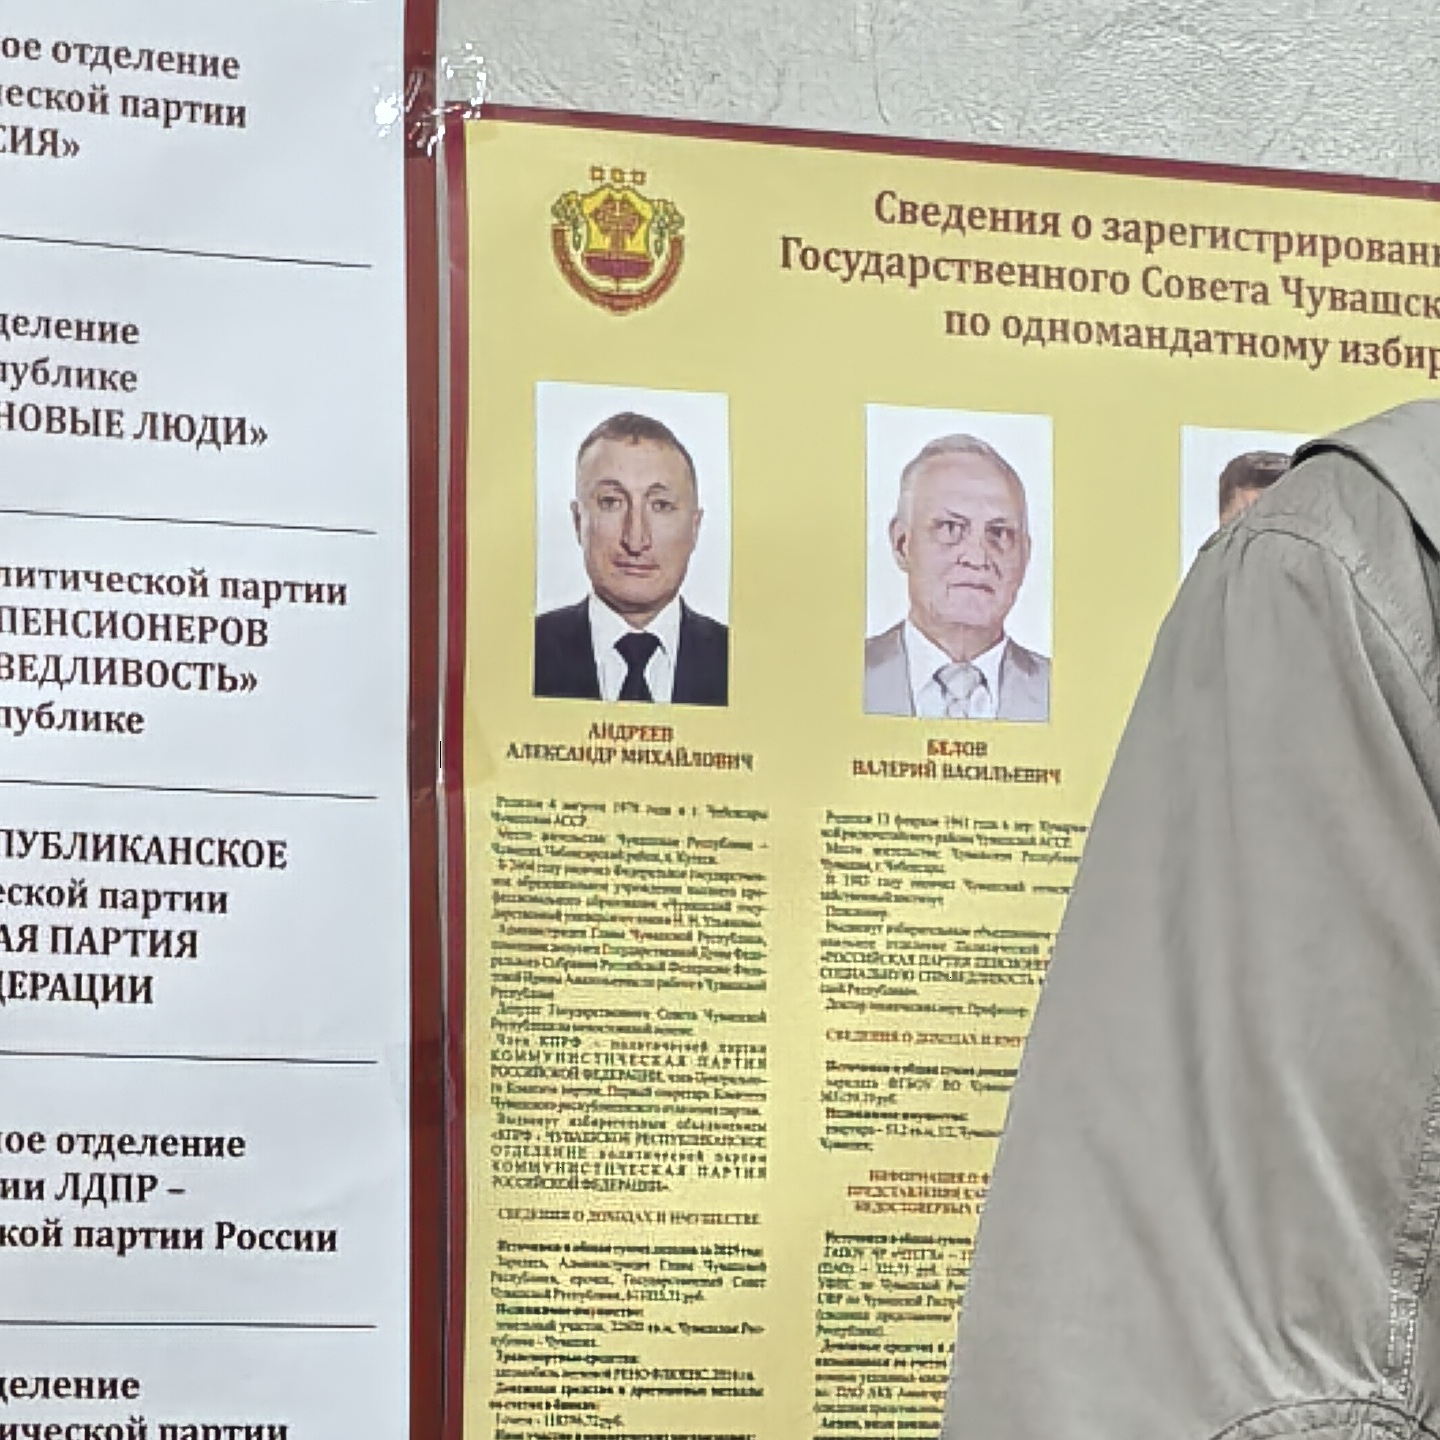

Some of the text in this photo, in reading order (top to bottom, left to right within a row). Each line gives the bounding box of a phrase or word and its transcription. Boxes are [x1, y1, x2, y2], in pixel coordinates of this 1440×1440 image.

[51, 40, 241, 80] отделение
[119, 94, 247, 129] партии
[875, 190, 1062, 238] Сведения
[1071, 214, 1092, 240] о
[779, 234, 1130, 295] Государственного
[1141, 263, 1272, 306] Совета
[943, 310, 991, 337] по
[1001, 314, 1332, 372] одномандатному
[132, 411, 268, 453] ЛЮДИ»
[218, 577, 347, 610] партии
[97, 885, 229, 920] партии
[46, 922, 200, 960] ПАРТИЯ
[53, 1131, 247, 1163] отделение
[53, 1171, 159, 1210] ЛДПР
[72, 1225, 205, 1258] партии
[214, 1219, 339, 1254] России
